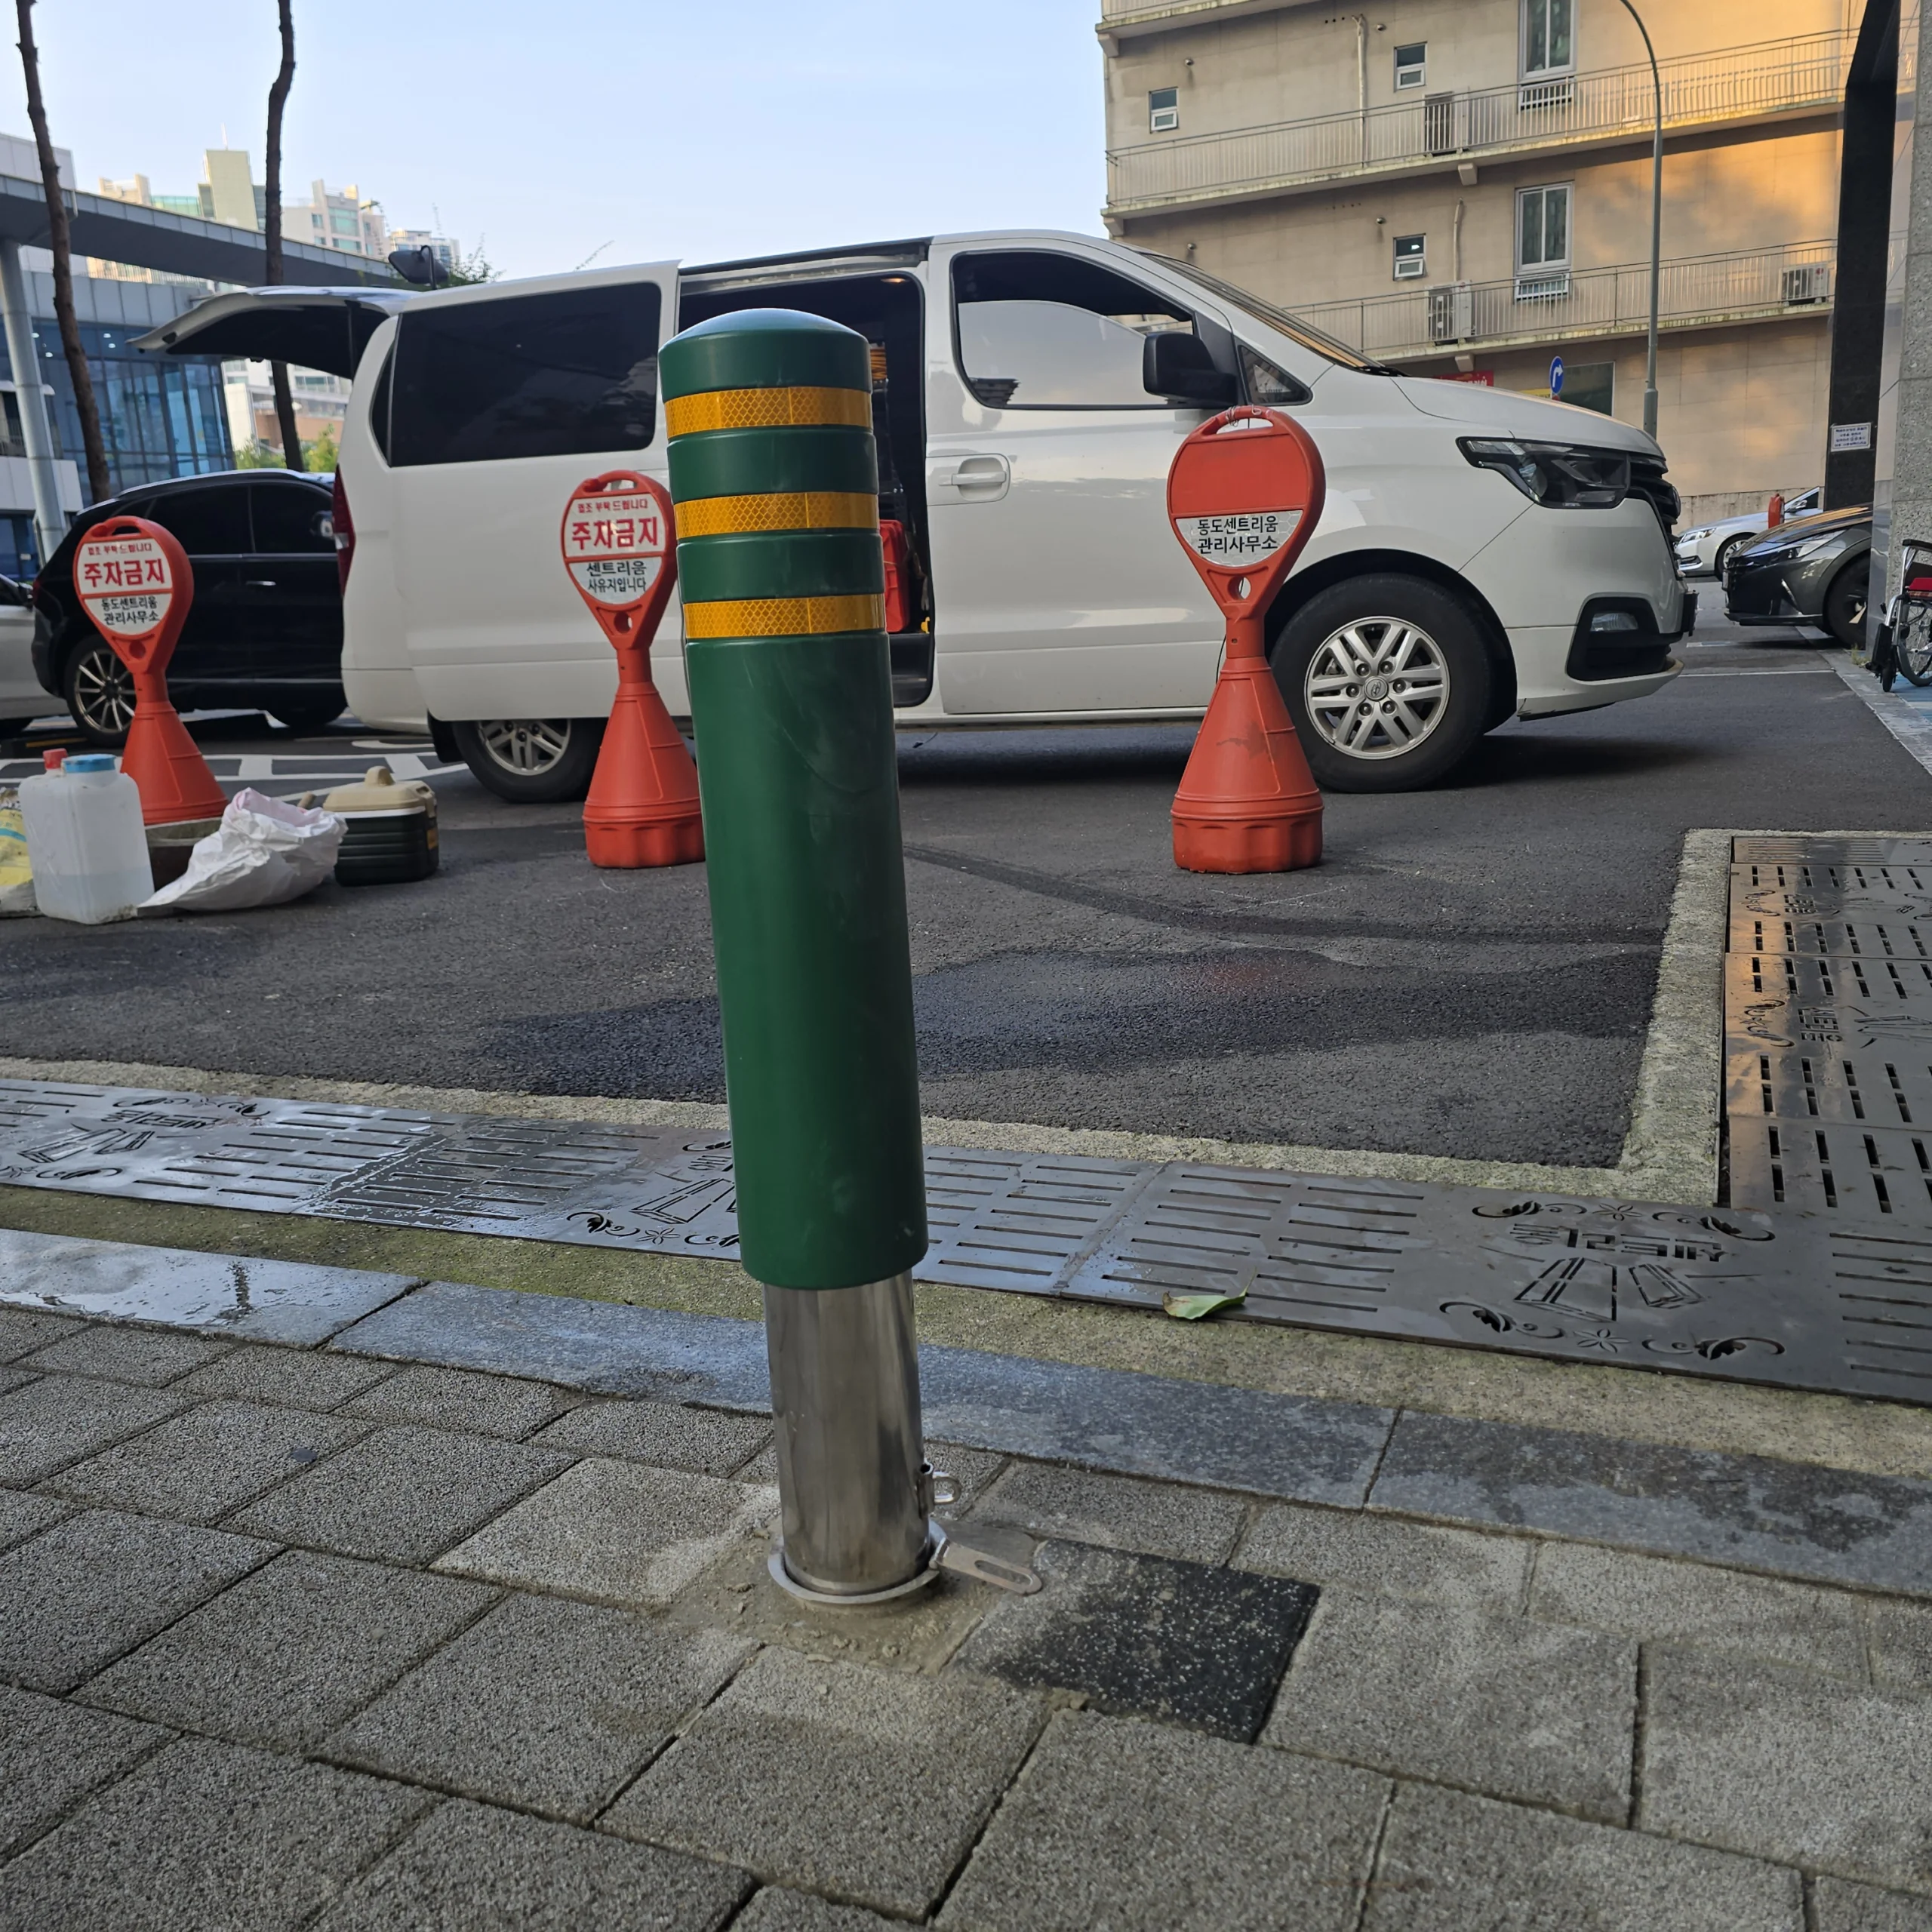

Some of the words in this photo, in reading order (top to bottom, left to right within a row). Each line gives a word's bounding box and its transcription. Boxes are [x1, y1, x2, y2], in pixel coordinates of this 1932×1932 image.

[572, 516, 658, 550] 주차금지
[1197, 515, 1278, 536] 동도센트리움
[1198, 535, 1278, 555] 관리사무소
[84, 558, 165, 588] 주차금지
[586, 561, 647, 577] 센트리움
[588, 577, 647, 593] 사유지입니다
[101, 595, 158, 611] 동도센트리움
[104, 610, 160, 626] 관리사무소
